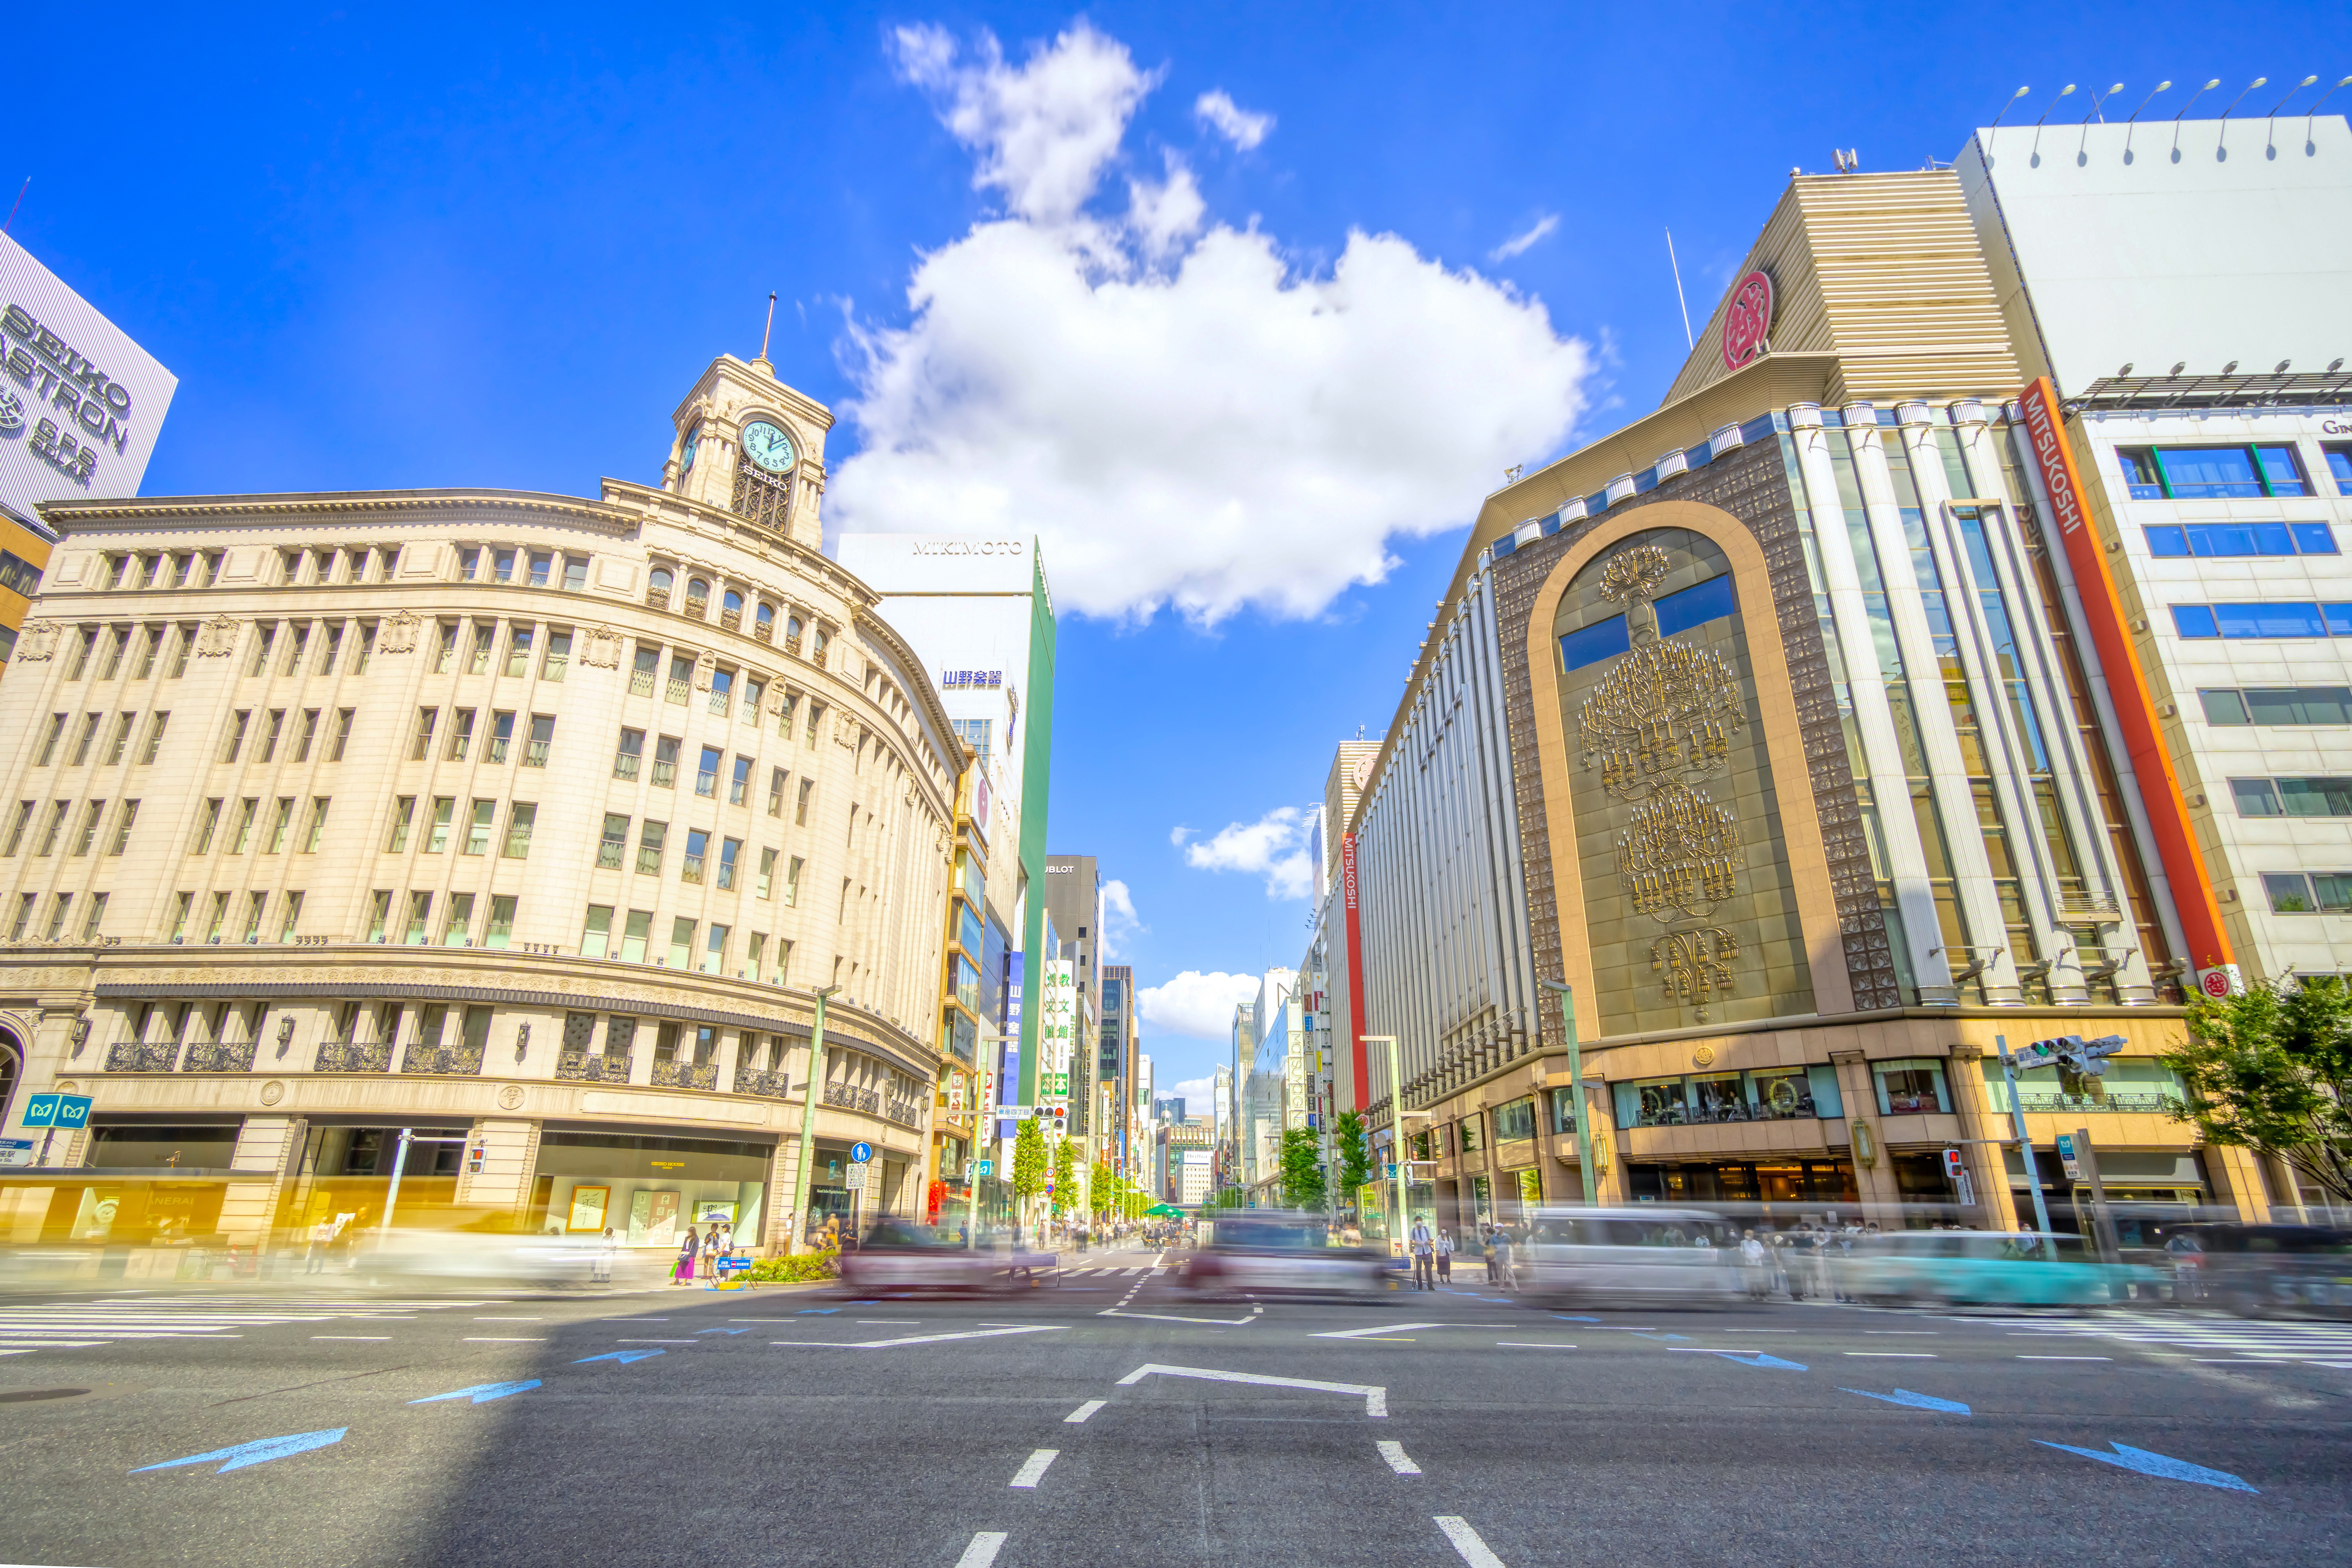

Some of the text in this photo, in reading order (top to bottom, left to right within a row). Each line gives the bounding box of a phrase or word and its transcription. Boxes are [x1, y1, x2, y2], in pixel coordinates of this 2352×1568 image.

[1, 303, 131, 410] SEIKO
[30, 435, 90, 483] SOLAR
[36, 417, 98, 467] GPS
[750, 443, 756, 451] 8
[757, 451, 763, 459] 7
[744, 465, 787, 491] SEIKO
[772, 459, 778, 467] 5
[2025, 391, 2081, 535] MITSUKOSHI
[913, 542, 1023, 555] MIKIMOTO
[943, 670, 1002, 685] 山野楽器
[1345, 838, 1356, 908] MITSUKOSHI
[1007, 985, 1022, 1053] 山野楽器
[1057, 973, 1070, 1039] 教文館
[1055, 1076, 1067, 1092] 本
